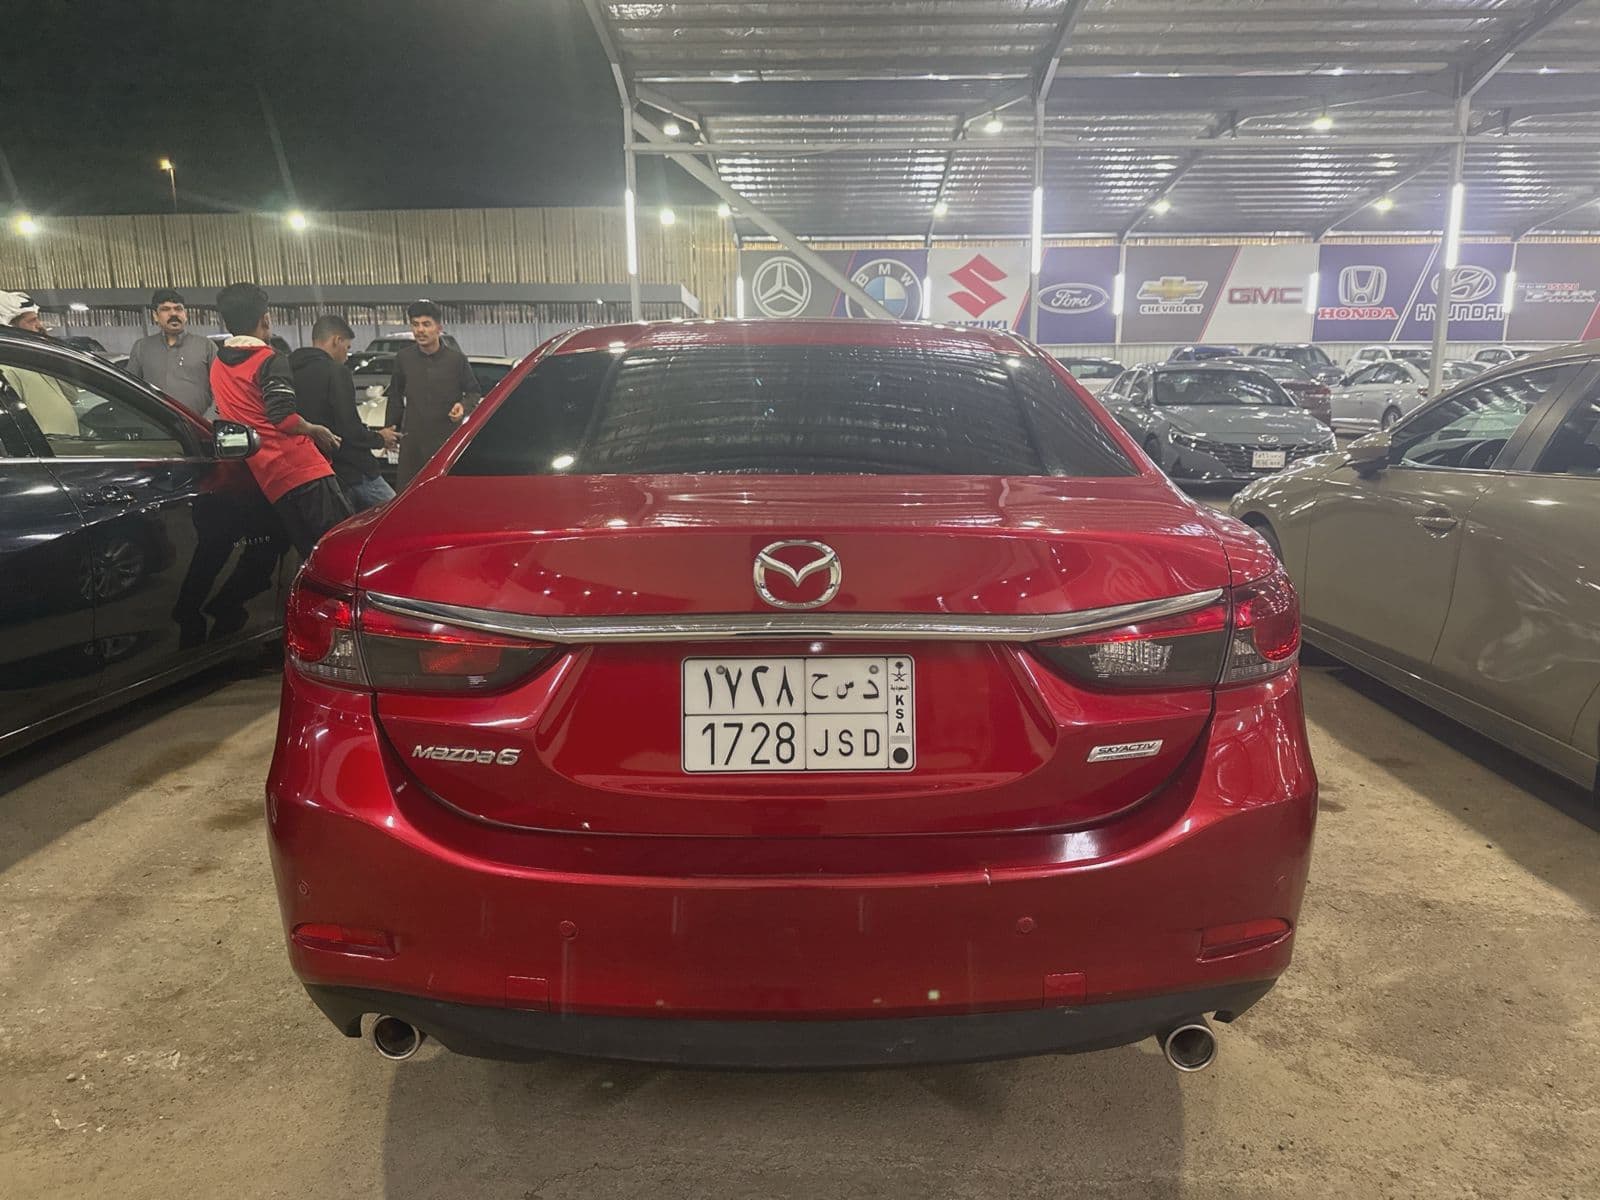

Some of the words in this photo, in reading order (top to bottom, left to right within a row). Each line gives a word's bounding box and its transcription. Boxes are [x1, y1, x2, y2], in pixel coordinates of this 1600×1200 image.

[856, 263, 914, 287] BMW
[1051, 289, 1092, 307] Ford
[1228, 287, 1303, 304] GMC
[1140, 304, 1203, 314] CHEVROLET
[1319, 307, 1398, 320] HONDA
[703, 665, 794, 709] ١٧٢٨
[895, 694, 905, 733] KSA
[702, 722, 795, 766] 1728
[1098, 743, 1156, 753] SKYACTIV
